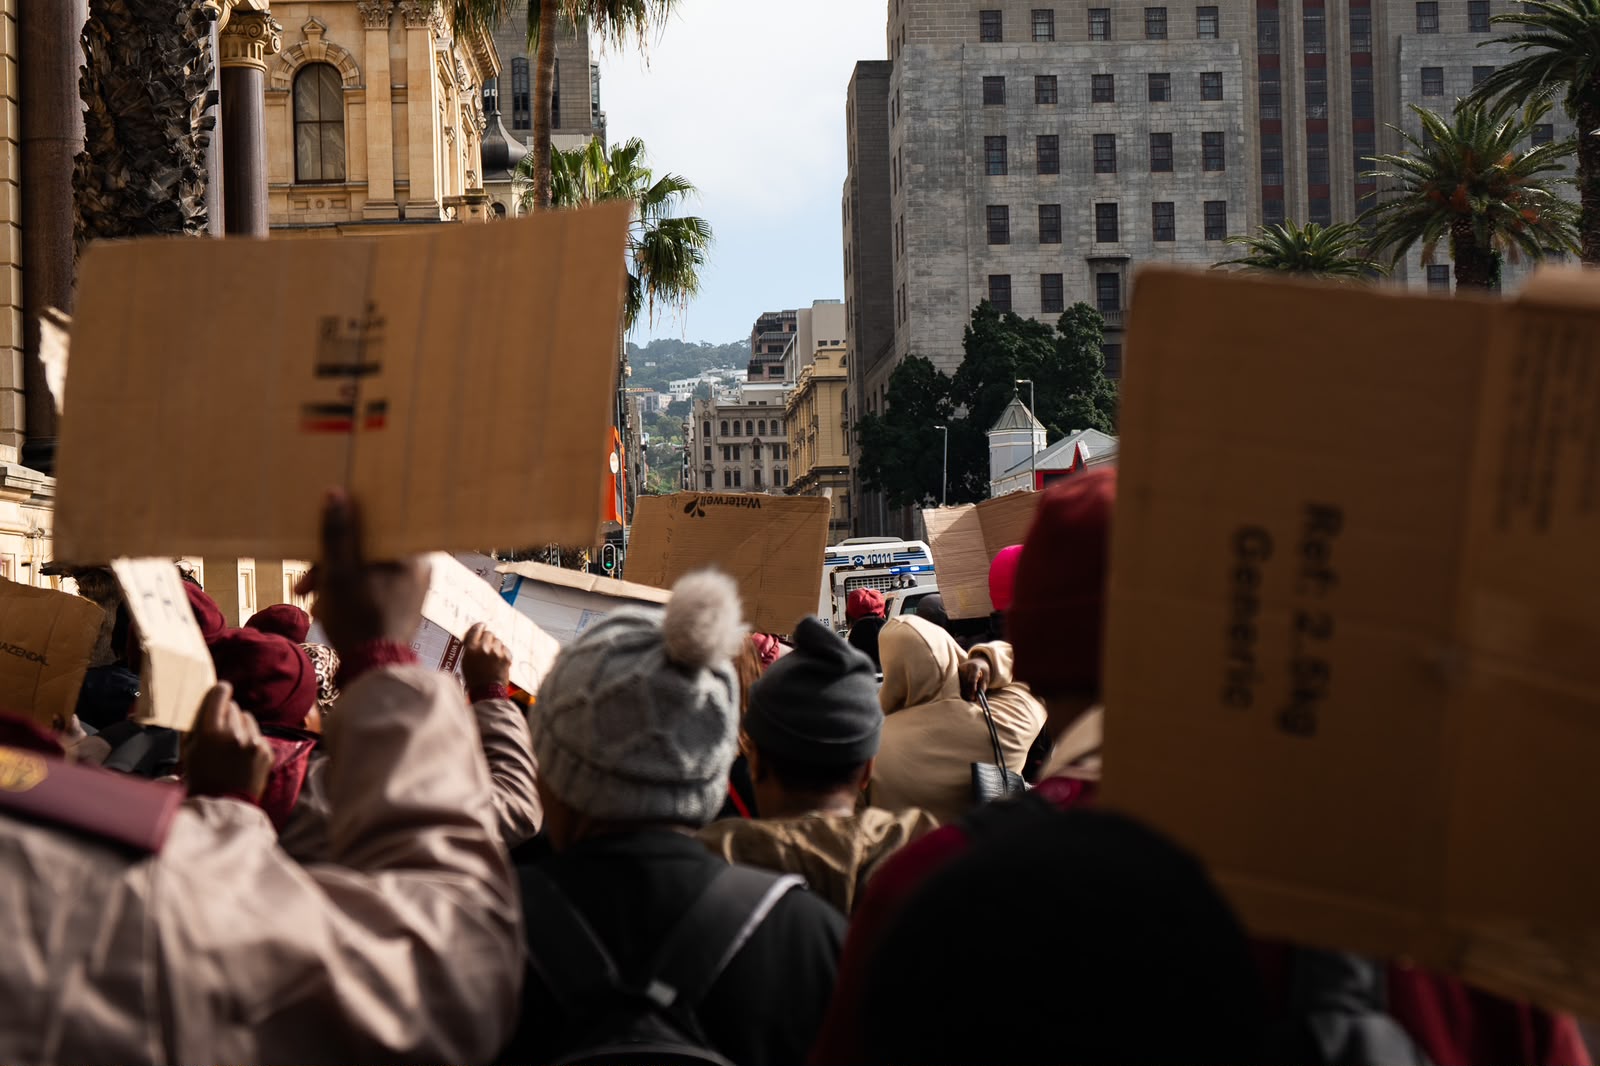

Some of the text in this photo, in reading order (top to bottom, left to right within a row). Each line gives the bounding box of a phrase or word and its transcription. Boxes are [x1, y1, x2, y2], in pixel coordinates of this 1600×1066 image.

[699, 496, 761, 509] Waterwell
[867, 553, 892, 566] 10111
[1220, 525, 1275, 711] Generic
